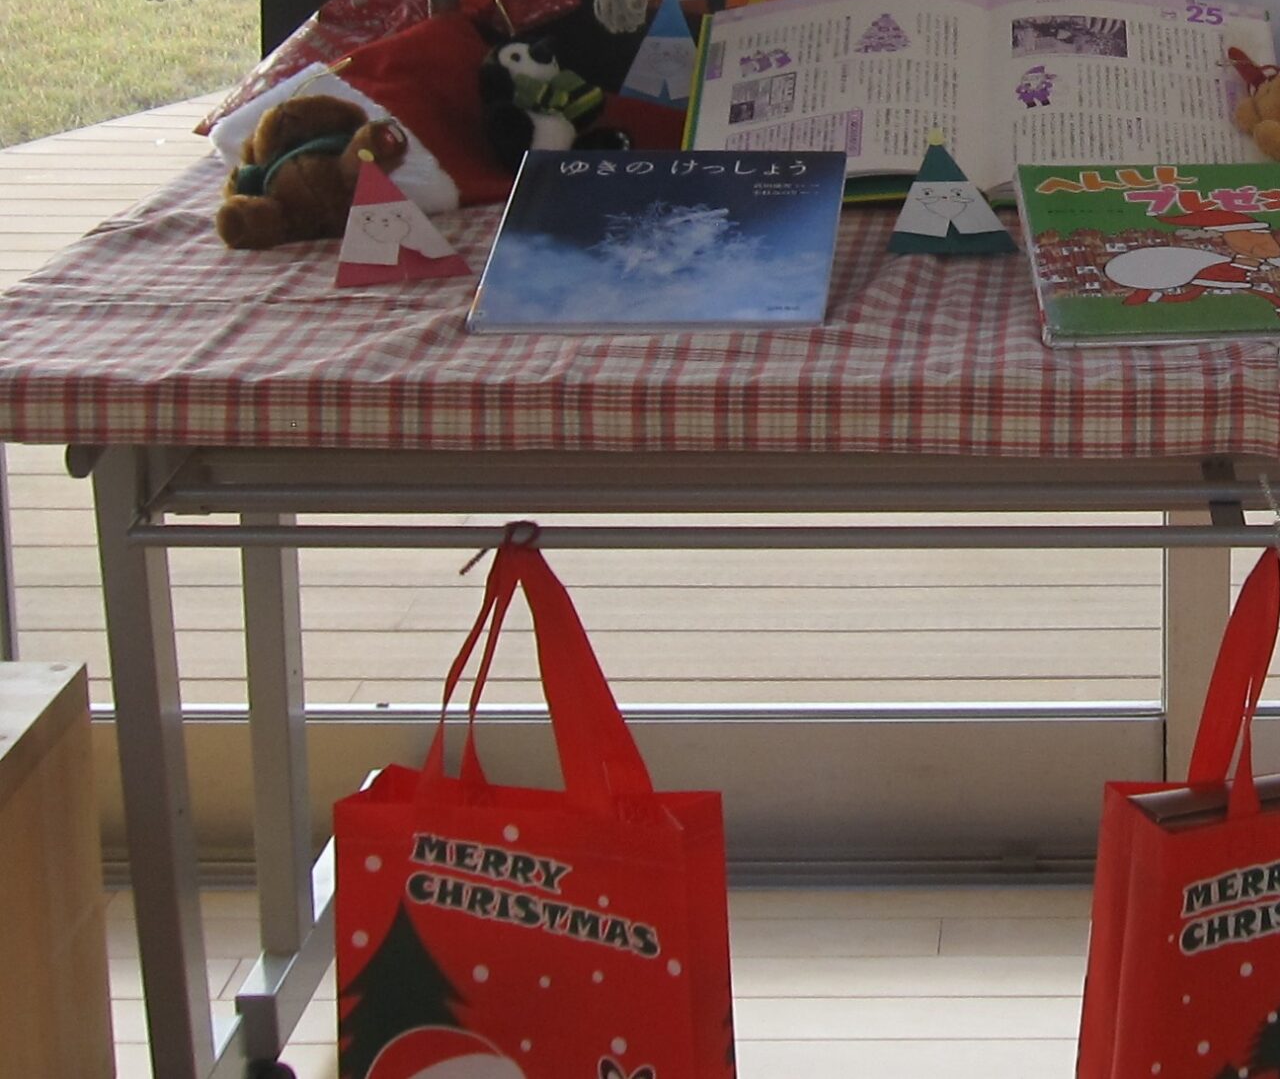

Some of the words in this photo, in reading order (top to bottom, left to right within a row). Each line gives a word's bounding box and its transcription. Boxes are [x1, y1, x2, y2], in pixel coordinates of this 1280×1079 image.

[1186, 5, 1224, 26] 25
[560, 160, 654, 176] ゆきの
[670, 159, 807, 176] けっしょう
[412, 832, 572, 894] MERRY
[407, 873, 661, 959] CHRISTMAS
